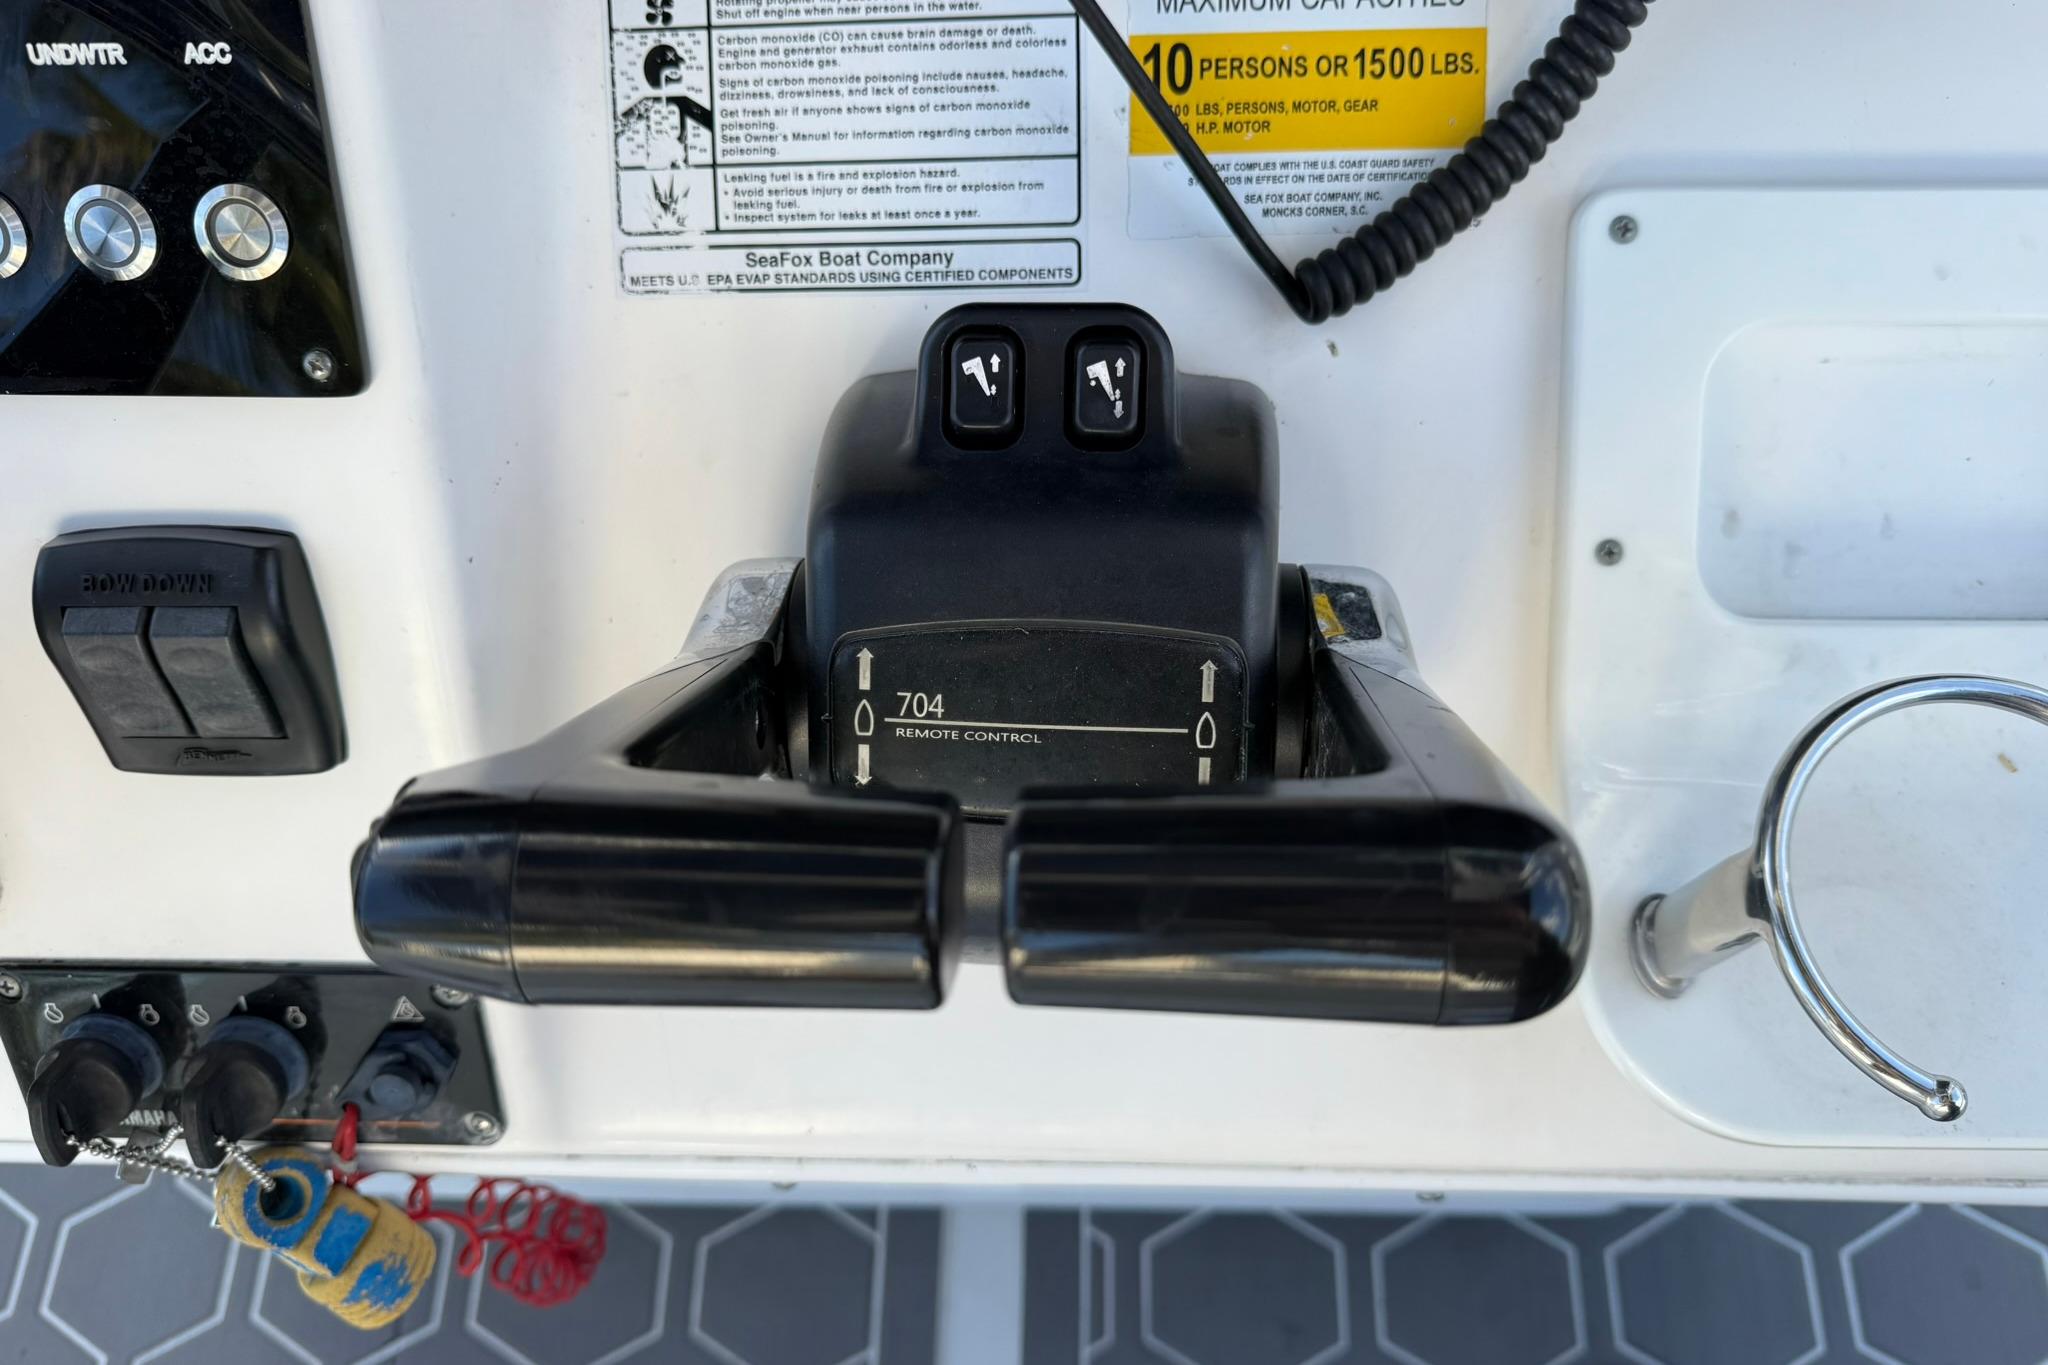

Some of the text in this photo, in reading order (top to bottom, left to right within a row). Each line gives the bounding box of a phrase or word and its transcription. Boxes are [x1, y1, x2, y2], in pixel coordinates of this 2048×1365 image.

[716, 9, 742, 19] Shut
[744, 9, 760, 18] off
[763, 7, 801, 20] engine
[804, 6, 834, 16] when
[836, 7, 861, 15] near
[864, 5, 910, 16] persons
[913, 3, 924, 12] in
[927, 3, 946, 12] the
[716, 35, 758, 45] Carbon
[760, 33, 816, 44] monoxide
[818, 32, 844, 43] (CO)
[846, 33, 867, 41] can
[870, 32, 904, 40] cause
[906, 29, 936, 39] brain
[938, 27, 983, 40] damage
[986, 28, 998, 36] or
[26, 43, 127, 65] UNDWTR
[184, 42, 232, 65] ACC
[718, 38, 1066, 60] Engine and generator exhaust contains odorless and colorless
[718, 60, 756, 70] carbon
[760, 58, 814, 69] monoxide
[1143, 43, 1480, 96] 10 PERSONS OR 1500 LBS.
[718, 78, 750, 90] Signs
[752, 77, 764, 86] of
[766, 76, 804, 86] carbon
[808, 74, 861, 85] monoxide
[864, 73, 919, 85] poisoning
[922, 72, 962, 81] include
[848, 87, 868, 97] and
[871, 87, 894, 96] lack
[897, 86, 908, 95] of
[720, 101, 1030, 118] Get fresh air if anyone shows signs of carbon monoxide
[1343, 100, 1378, 112] GEAR
[720, 126, 1069, 143] See Owner's Manual for information regarding carbon monoxide
[1222, 119, 1270, 133] MOTOR
[1212, 162, 1231, 172] OAT
[1234, 161, 1276, 171] COMPLIES
[1278, 160, 1300, 170] WITH
[1302, 160, 1318, 170] THE
[1338, 159, 1368, 169] COAST
[1370, 158, 1400, 168] GUARD
[1402, 157, 1434, 167] SAFETY
[724, 173, 766, 185] Leaking
[770, 172, 790, 182] fuel
[794, 172, 804, 181] is
[816, 171, 836, 181] fire
[838, 171, 859, 180] and
[862, 170, 916, 182] explosion
[1244, 175, 1253, 184] IN
[1255, 174, 1290, 183] EFFECT
[1291, 174, 1306, 183] ON
[1308, 173, 1325, 183] THE
[1326, 173, 1350, 183] DATE
[1352, 172, 1365, 182] OF
[1366, 171, 1428, 182] CERTIFICATIO
[733, 187, 764, 197] Avoid
[767, 186, 808, 196] serious
[811, 186, 843, 197] injury
[860, 184, 892, 194] death
[894, 184, 921, 193] from
[924, 183, 943, 192] fire
[960, 182, 1015, 194] explosion
[1018, 181, 1044, 190] from
[733, 200, 773, 212] leaking
[1244, 193, 1263, 204] SEA
[1264, 192, 1284, 203] FOX
[1286, 192, 1312, 203] BOAT
[734, 212, 774, 224] Inspect
[777, 212, 816, 223] system
[819, 211, 835, 220] for
[838, 211, 868, 220] leaks
[870, 210, 880, 219] at
[884, 210, 910, 219] least
[914, 211, 941, 219] once
[1262, 206, 1303, 217] MONCKS
[745, 250, 954, 269] SeaFox Boat Company
[630, 275, 674, 286] MEETS
[706, 274, 732, 285] EPA
[736, 273, 770, 284] EVAP
[774, 272, 856, 283] STANDARDS
[859, 271, 901, 282] USING
[904, 270, 975, 281] CERTIFIED
[978, 268, 1073, 280] COMPONENTS
[82, 572, 213, 593] BOW DOWN
[896, 692, 944, 719] 704
[895, 727, 1042, 744] REMOTE CONTROL
